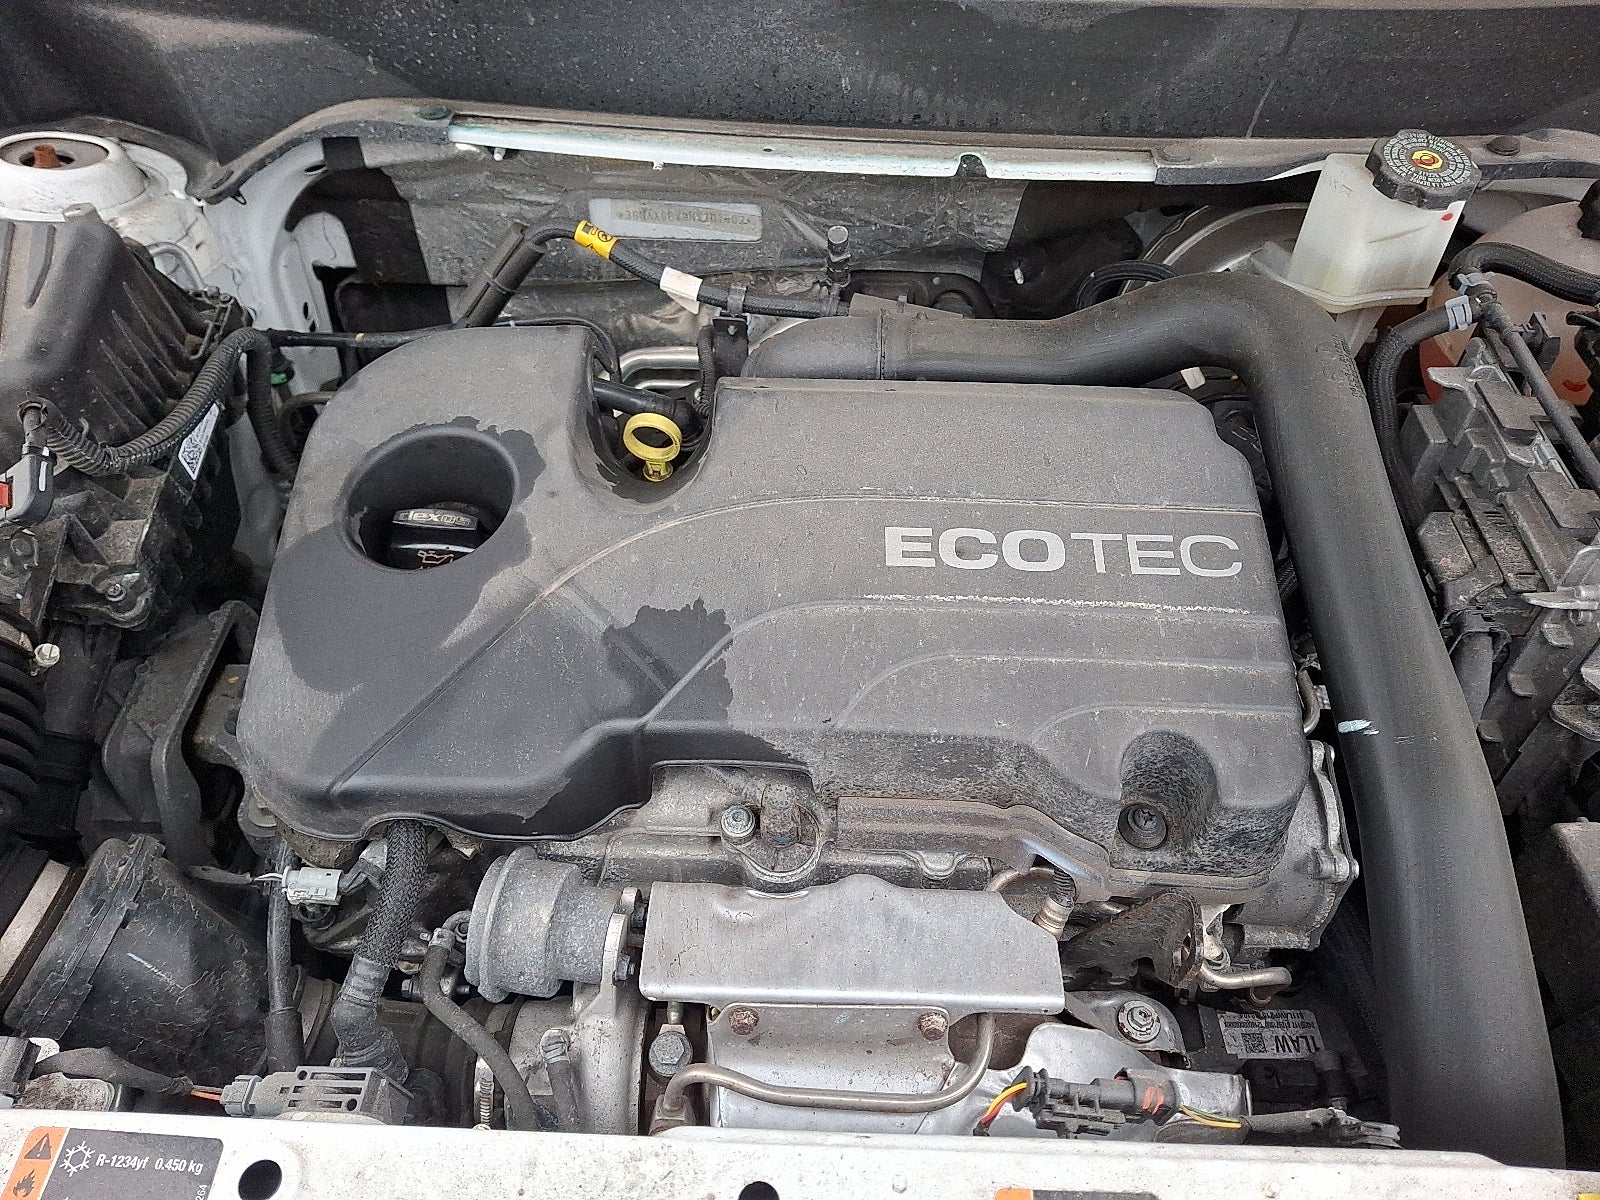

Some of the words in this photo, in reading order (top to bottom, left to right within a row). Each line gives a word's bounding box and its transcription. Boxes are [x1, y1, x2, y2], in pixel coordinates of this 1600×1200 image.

[399, 510, 470, 526] dexos
[884, 526, 1244, 577] ECOTEC
[1274, 1035, 1321, 1053] 1LAW
[96, 1153, 149, 1170] R-1234yf
[154, 1158, 187, 1172] 0.450
[188, 1160, 203, 1175] kg
